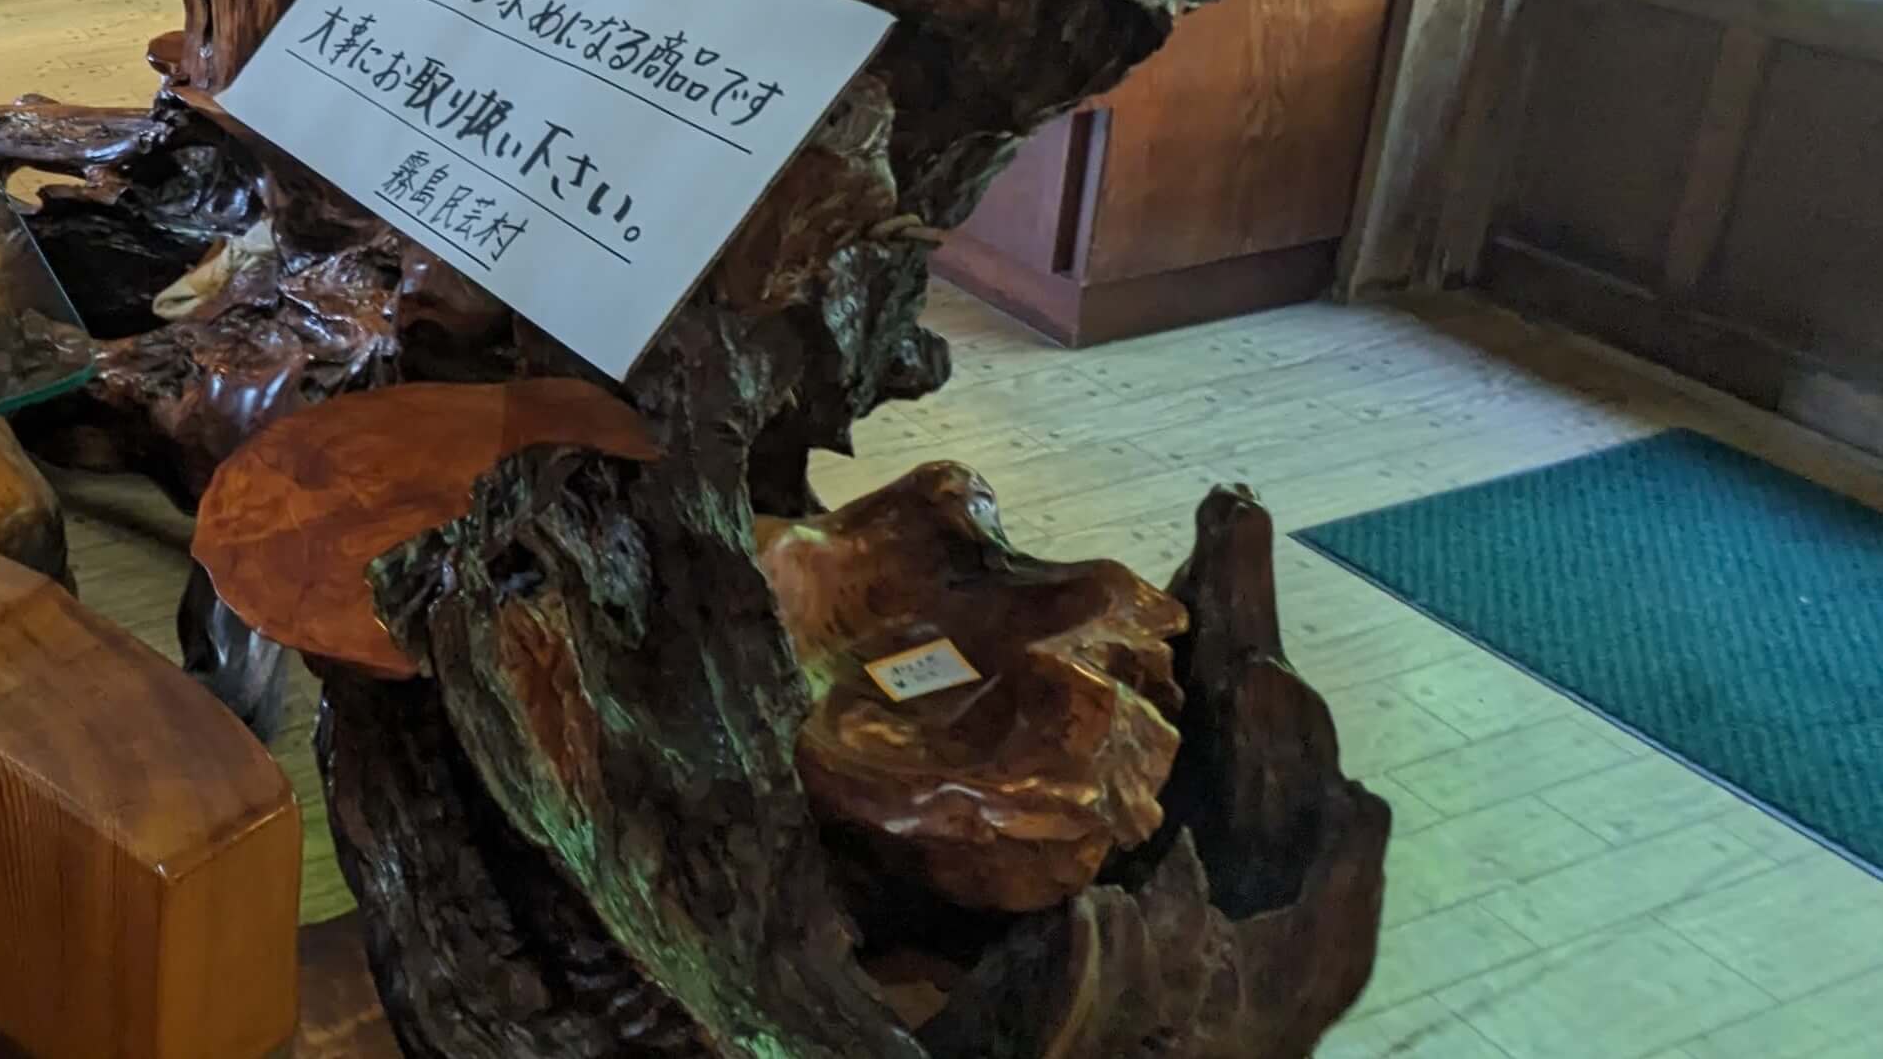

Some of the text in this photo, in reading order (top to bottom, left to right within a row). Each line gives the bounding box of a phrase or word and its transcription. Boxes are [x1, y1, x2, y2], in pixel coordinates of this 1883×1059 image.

[380, 149, 530, 263] 霧島民芸村
